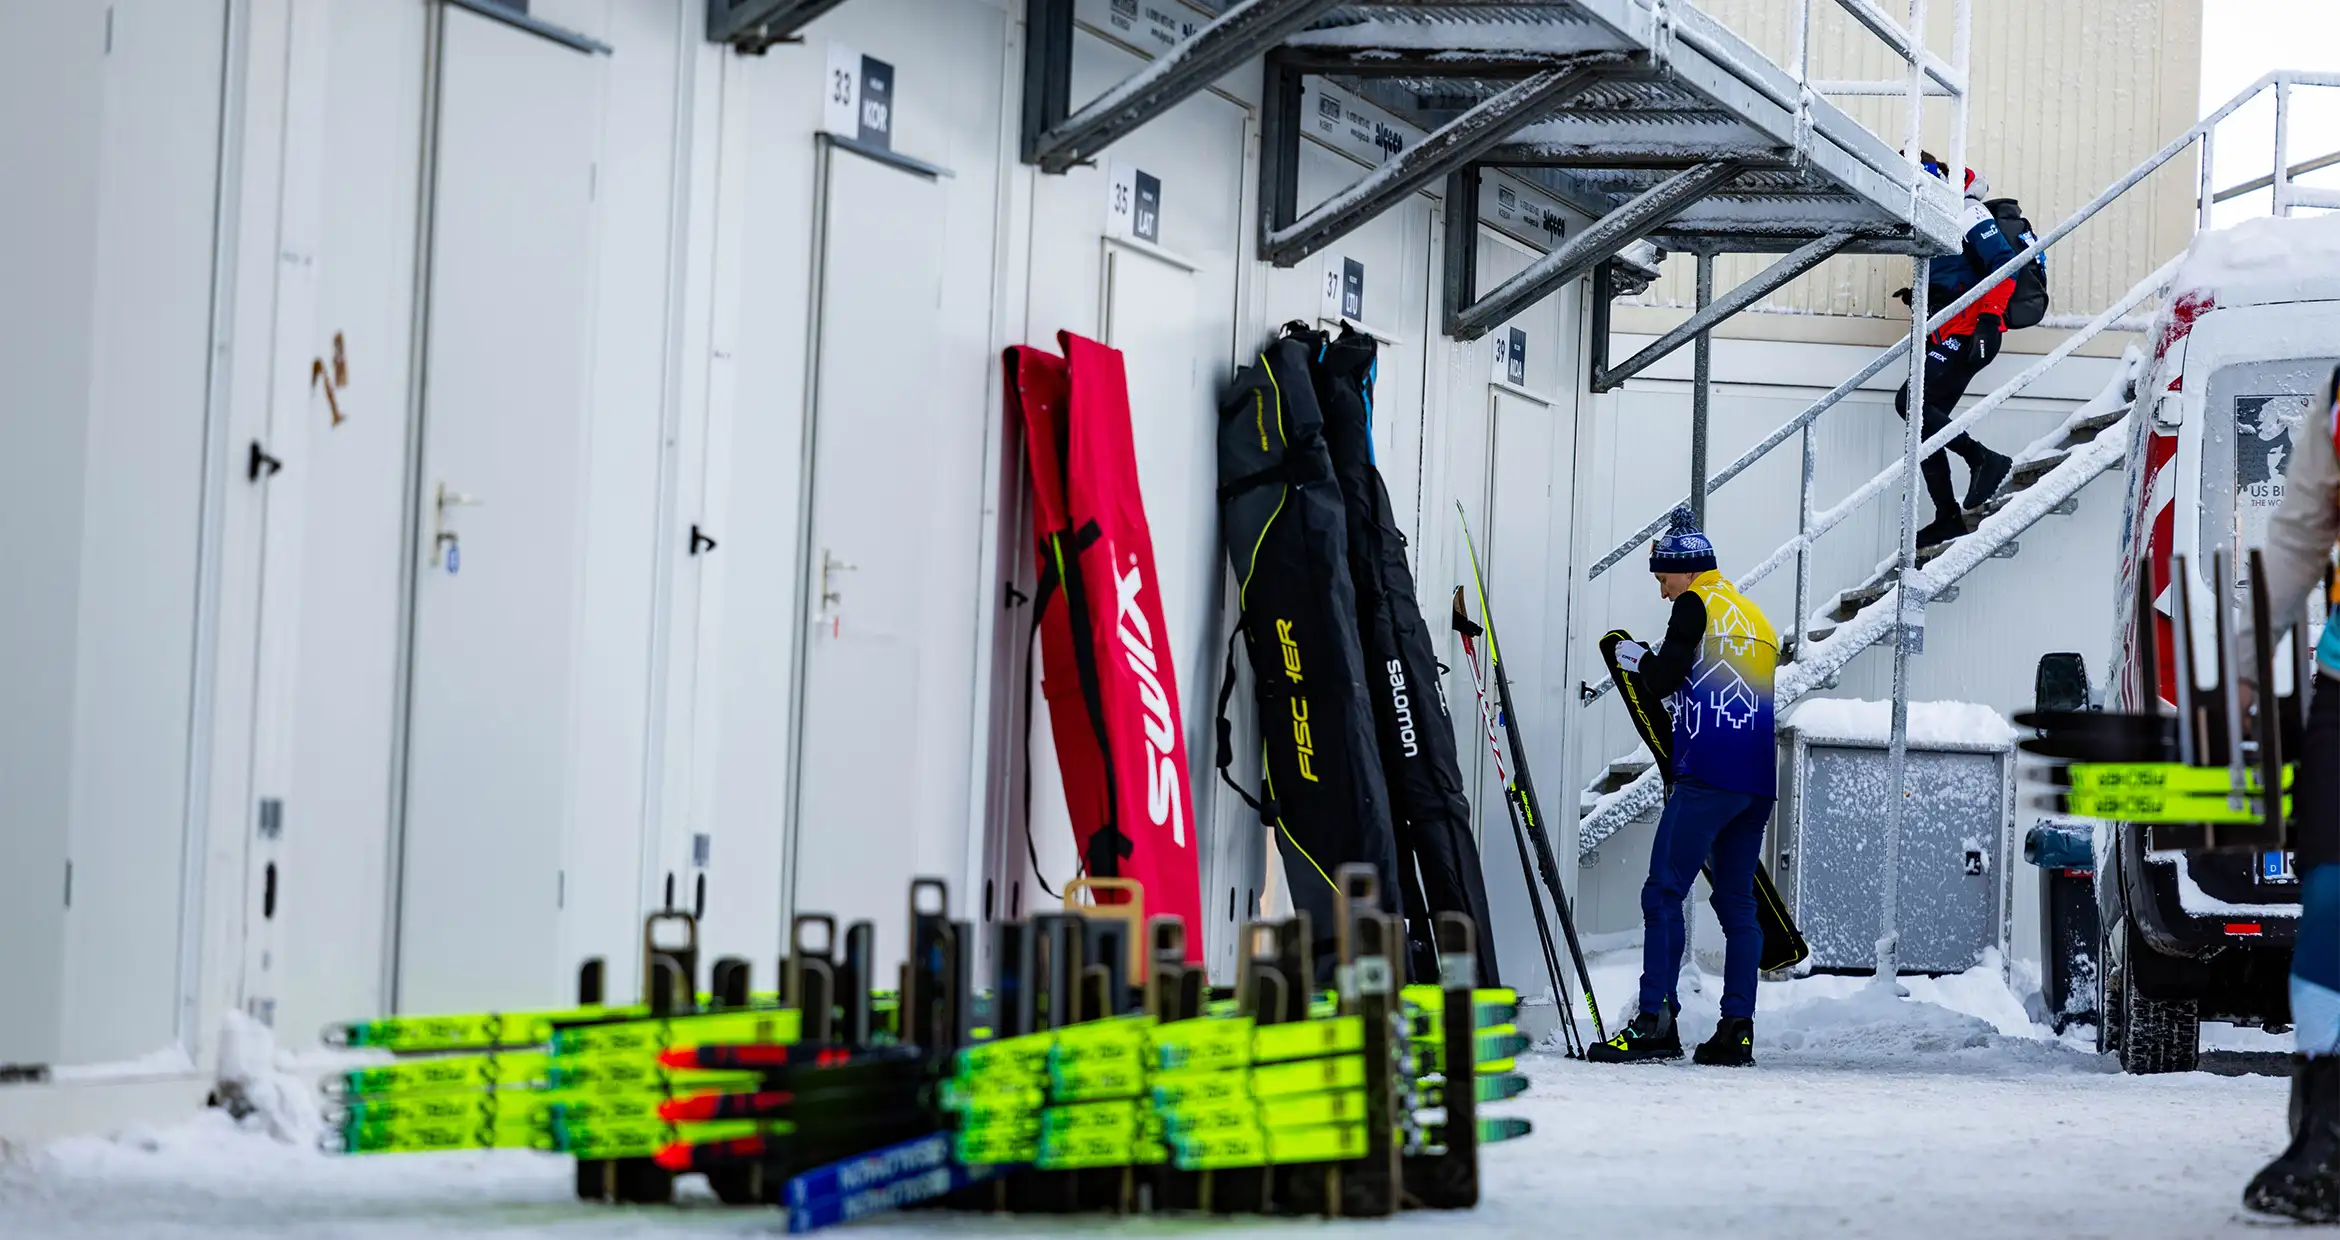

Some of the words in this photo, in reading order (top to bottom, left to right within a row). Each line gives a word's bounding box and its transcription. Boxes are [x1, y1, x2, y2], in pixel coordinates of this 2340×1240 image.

[833, 69, 852, 106] 33
[862, 99, 888, 133] KOR
[1114, 182, 1128, 215] 35
[1138, 209, 1155, 237] LAT
[1327, 271, 1338, 300] 37
[1346, 291, 1359, 316] LTU
[1496, 338, 1506, 364] 39
[2251, 485, 2269, 497] US
[2273, 485, 2285, 497] BI
[2251, 499, 2266, 507] THE
[2268, 499, 2283, 507] WO
[1109, 541, 1186, 849] SWIX
[2270, 864, 2277, 873] D
